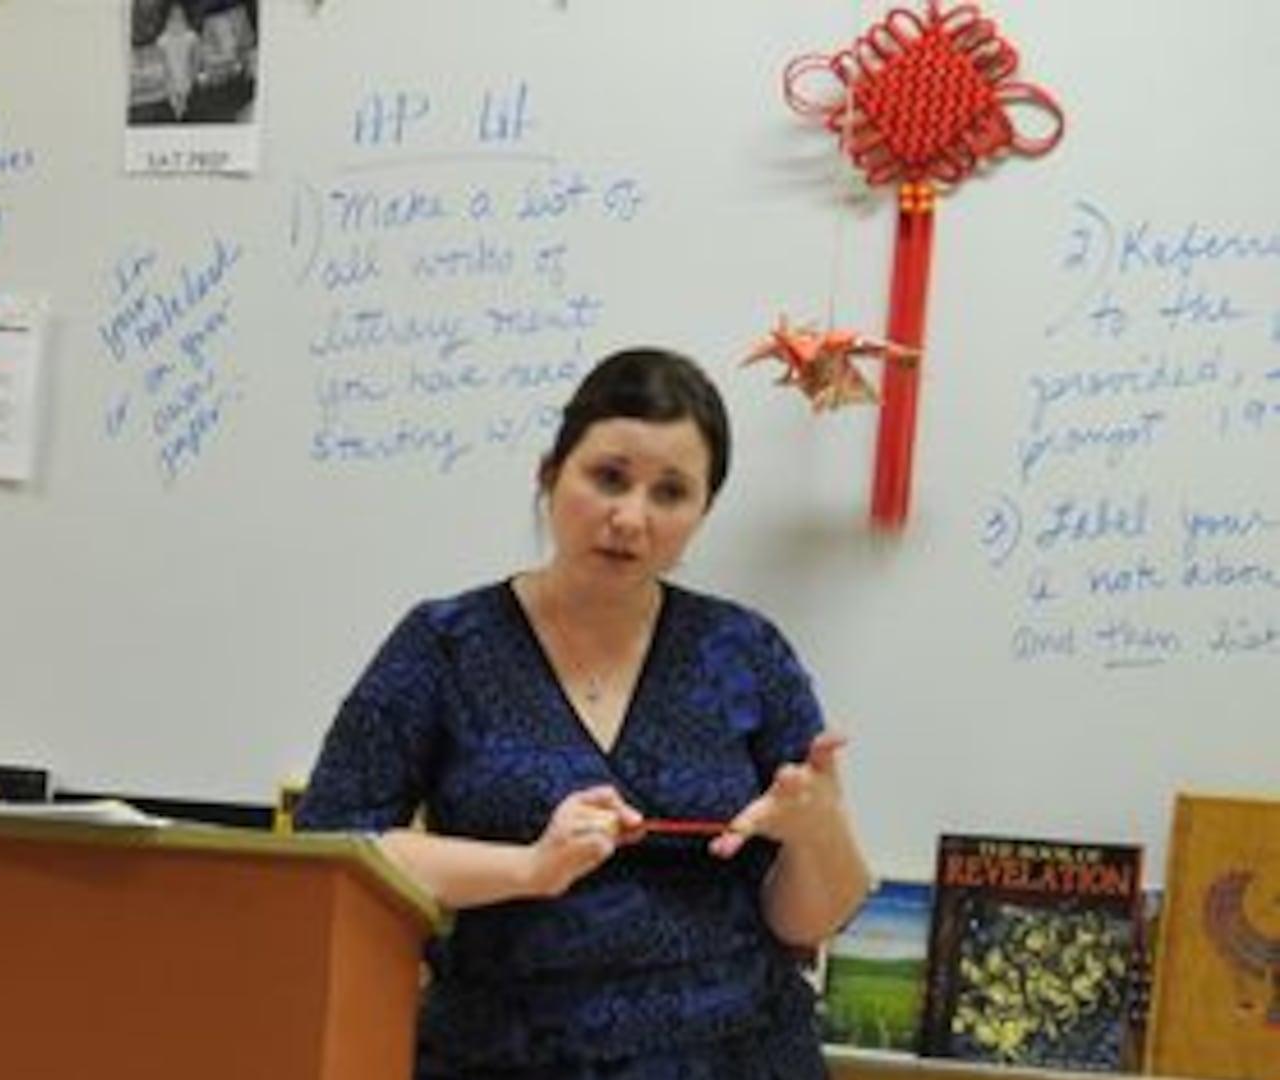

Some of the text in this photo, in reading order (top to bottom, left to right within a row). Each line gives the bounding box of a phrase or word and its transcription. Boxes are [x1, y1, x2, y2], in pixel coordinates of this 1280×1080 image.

[351, 90, 431, 144] AP
[330, 187, 450, 231] Make
[469, 188, 494, 220] a
[517, 173, 591, 221] list
[601, 177, 646, 222] of
[320, 236, 568, 289] all works of
[1089, 291, 1128, 338] to
[1158, 288, 1246, 329] the
[313, 373, 390, 426] you
[409, 358, 490, 395] have
[1036, 496, 1149, 550] Label
[1180, 502, 1280, 563] your
[945, 854, 1131, 897] REVELATION
